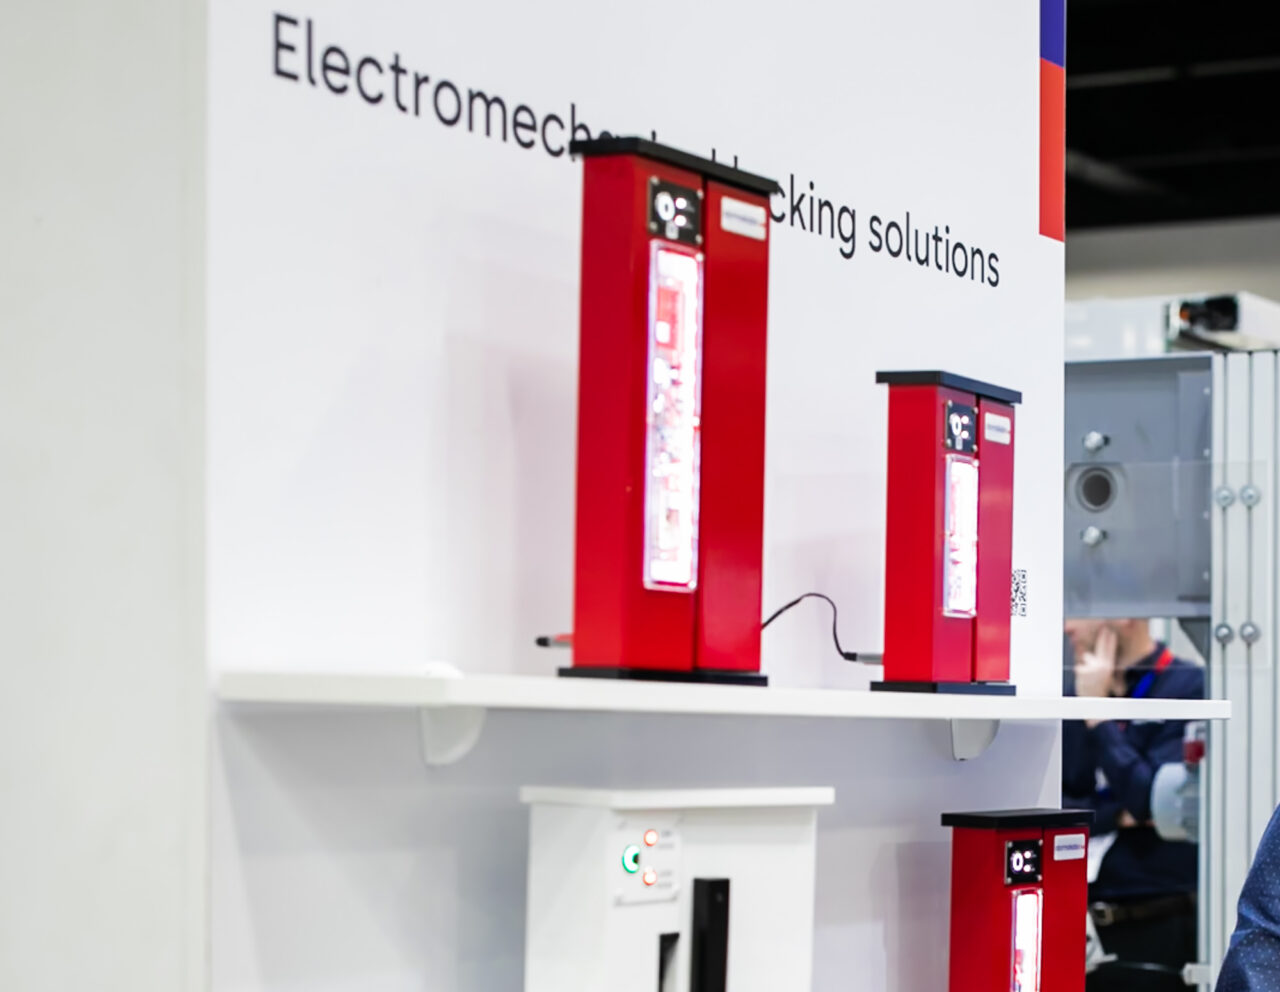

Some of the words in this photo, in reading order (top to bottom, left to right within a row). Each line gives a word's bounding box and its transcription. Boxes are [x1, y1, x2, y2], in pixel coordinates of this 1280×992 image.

[273, 12, 716, 163] Electromech
[733, 154, 856, 259] cking
[868, 210, 1000, 287] solutions
